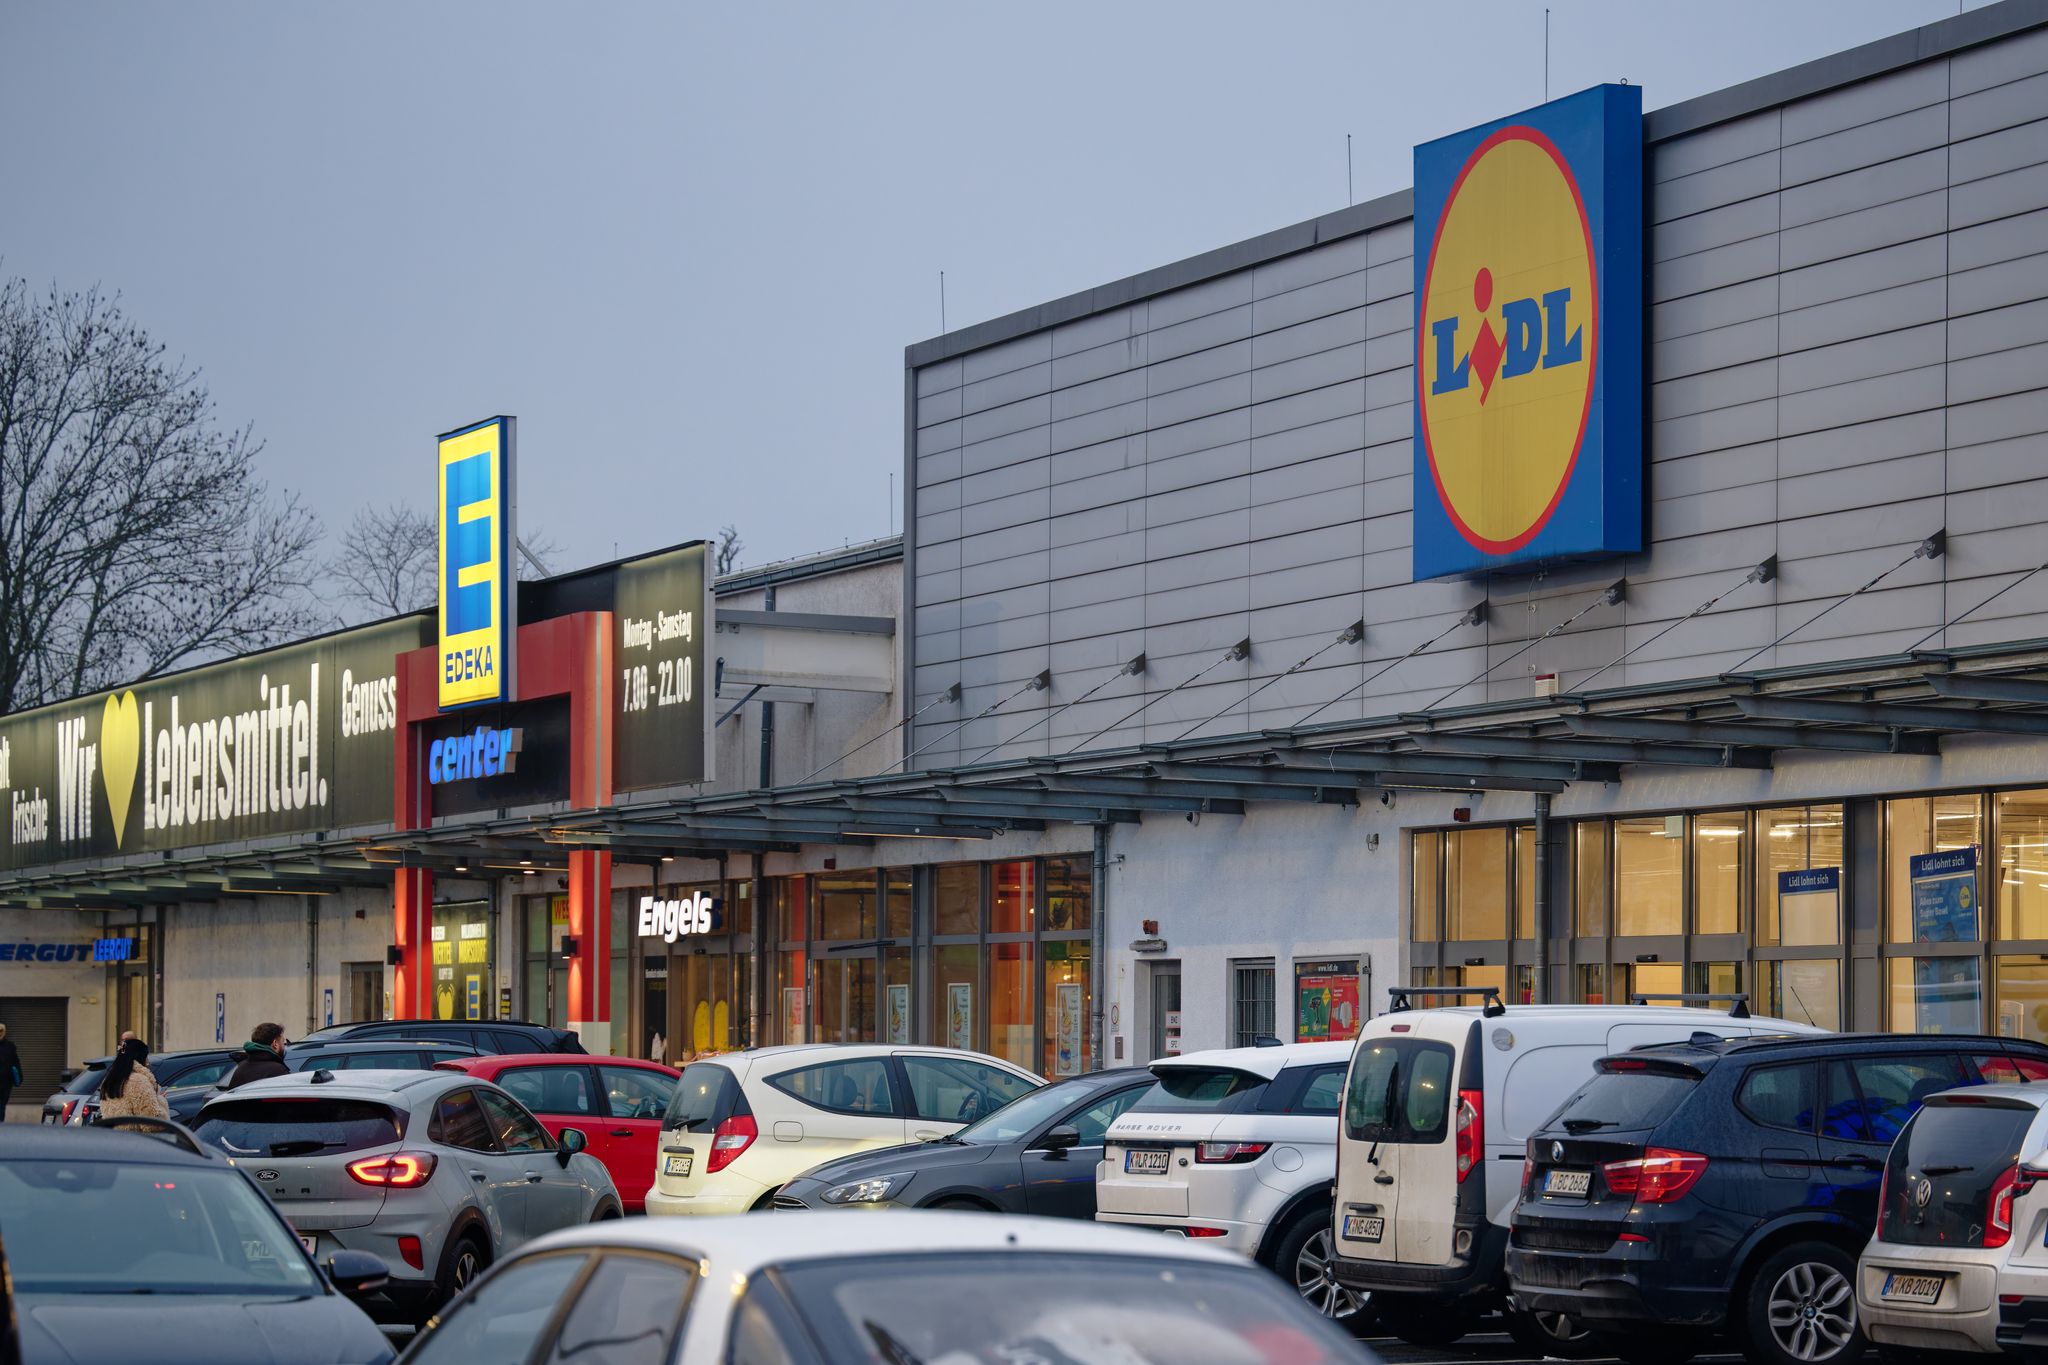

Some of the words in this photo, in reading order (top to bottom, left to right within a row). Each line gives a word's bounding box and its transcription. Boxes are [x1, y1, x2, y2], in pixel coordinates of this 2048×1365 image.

[623, 619, 652, 651] Montag
[658, 609, 692, 642] Samstag
[445, 645, 494, 684] EDEKA
[623, 664, 648, 713] 7.00
[658, 656, 692, 706] 22.00
[341, 668, 397, 738] Genuss
[58, 716, 96, 842] Wir
[144, 662, 328, 830] Lebensmittel.
[429, 726, 514, 784] center
[12, 786, 48, 845] Frische
[1789, 876, 1800, 887] Lidl
[1800, 875, 1816, 886] lohnt
[1817, 874, 1829, 885] sich
[1921, 859, 1934, 871] Lidl
[1935, 858, 1951, 869] lohnt
[1952, 856, 1965, 867] sich
[638, 891, 712, 943] Engels
[93, 938, 132, 961] LEERGUT
[260, 1171, 275, 1179] Ford
[1913, 1278, 1940, 1297] 2019
